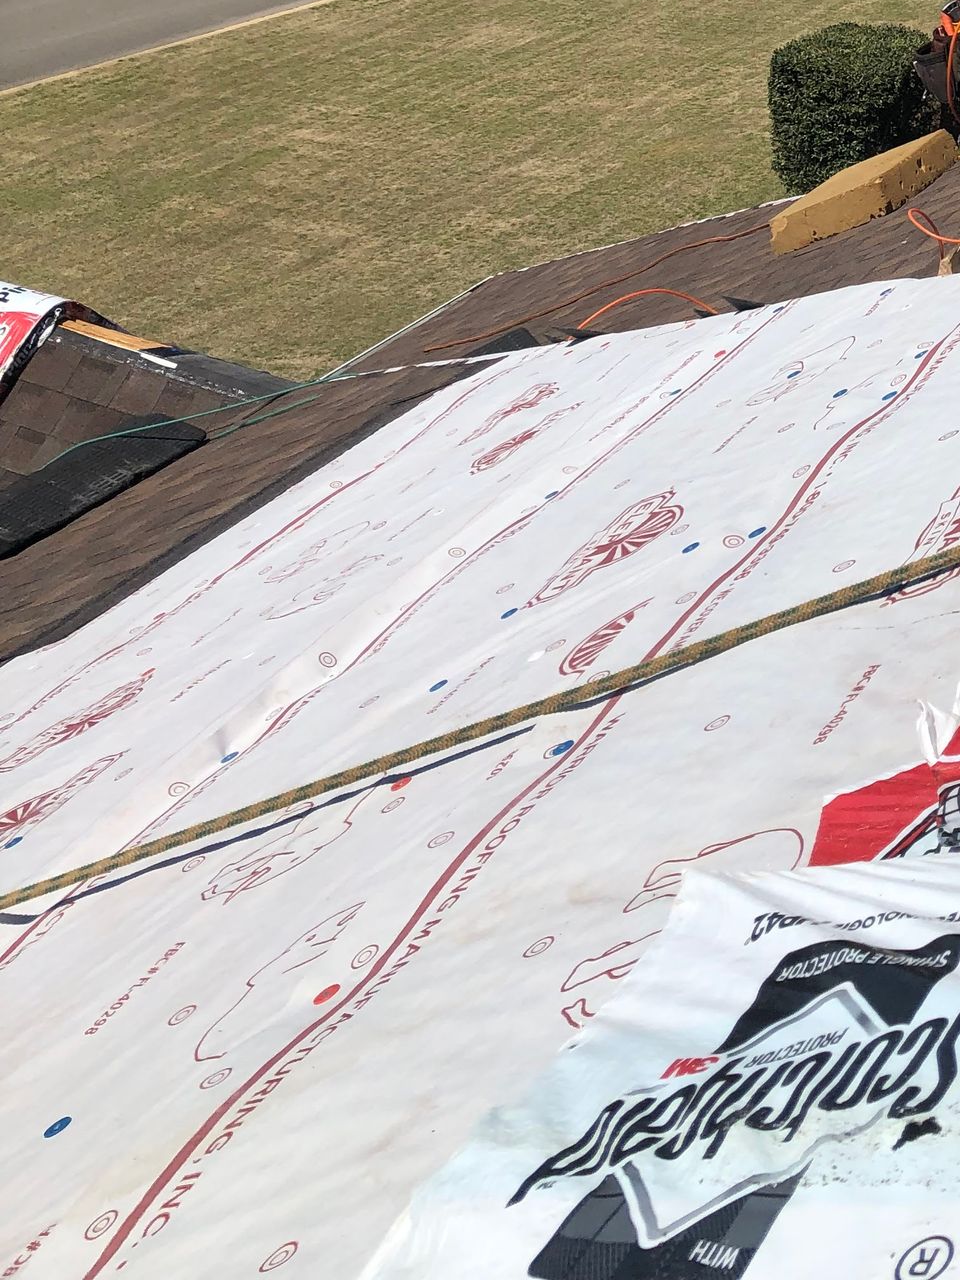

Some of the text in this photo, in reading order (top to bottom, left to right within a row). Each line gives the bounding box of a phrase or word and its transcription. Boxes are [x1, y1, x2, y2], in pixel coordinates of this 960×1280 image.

[923, 511, 952, 547] SKIN
[435, 803, 536, 913] ROOFING
[775, 946, 864, 982] PROTECTOR
[660, 1026, 846, 1081] PROTECTOR 3M
[687, 1238, 743, 1270] WITH
